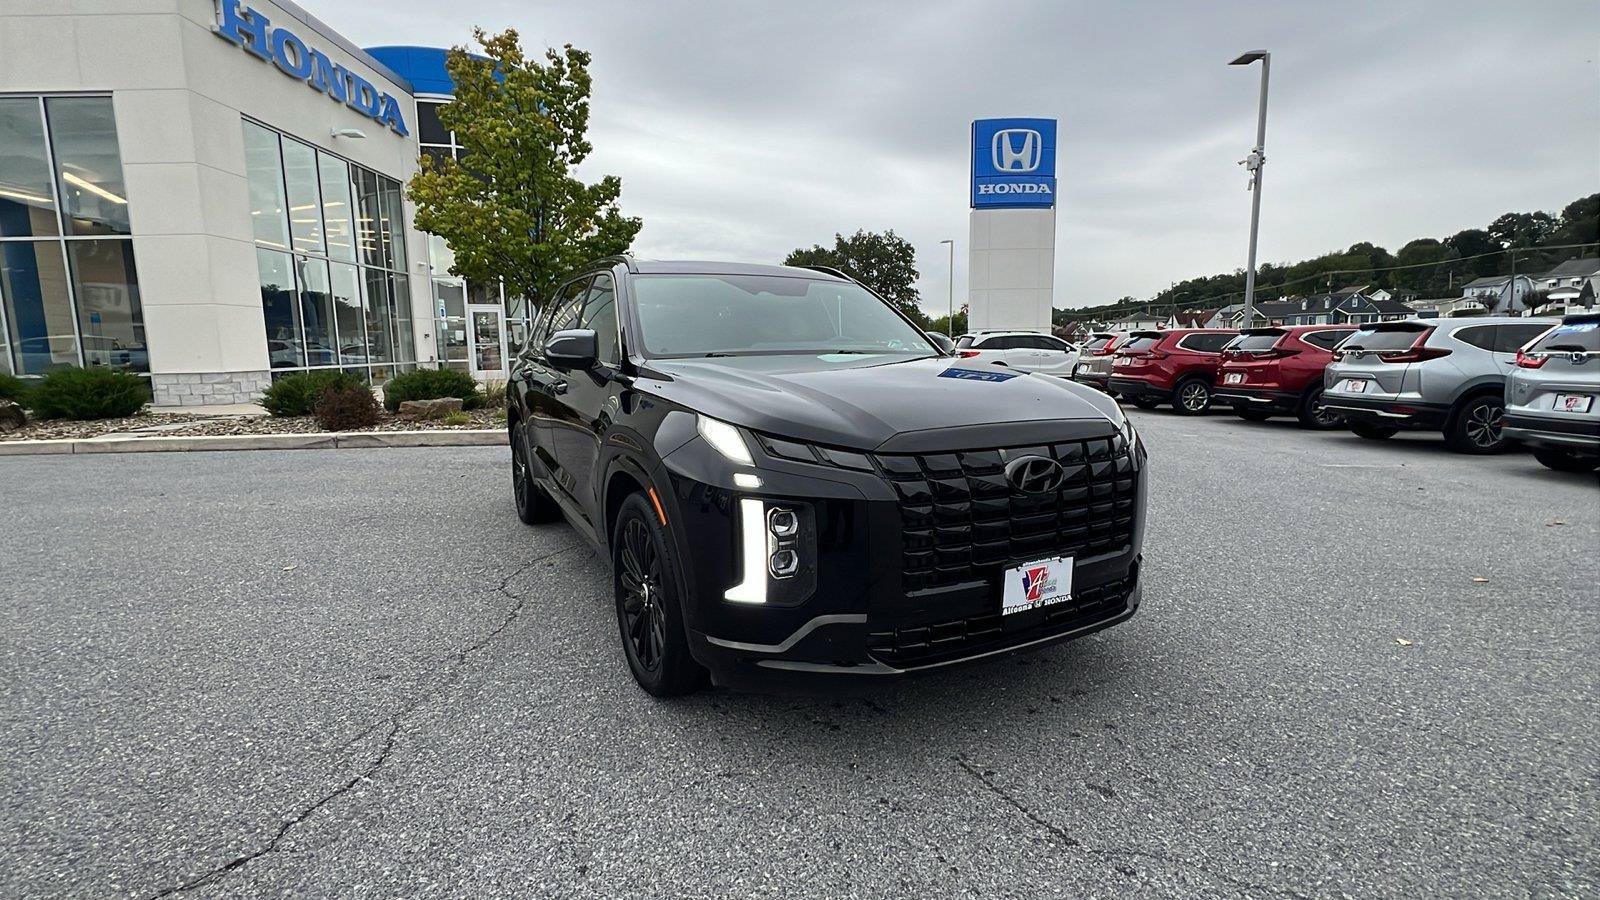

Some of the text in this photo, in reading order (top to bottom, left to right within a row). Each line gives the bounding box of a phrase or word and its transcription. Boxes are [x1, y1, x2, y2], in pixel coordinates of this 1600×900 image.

[212, 0, 409, 137] HONDA
[978, 183, 1052, 195] HONDA
[1002, 594, 1073, 616] Altoona HONDA
